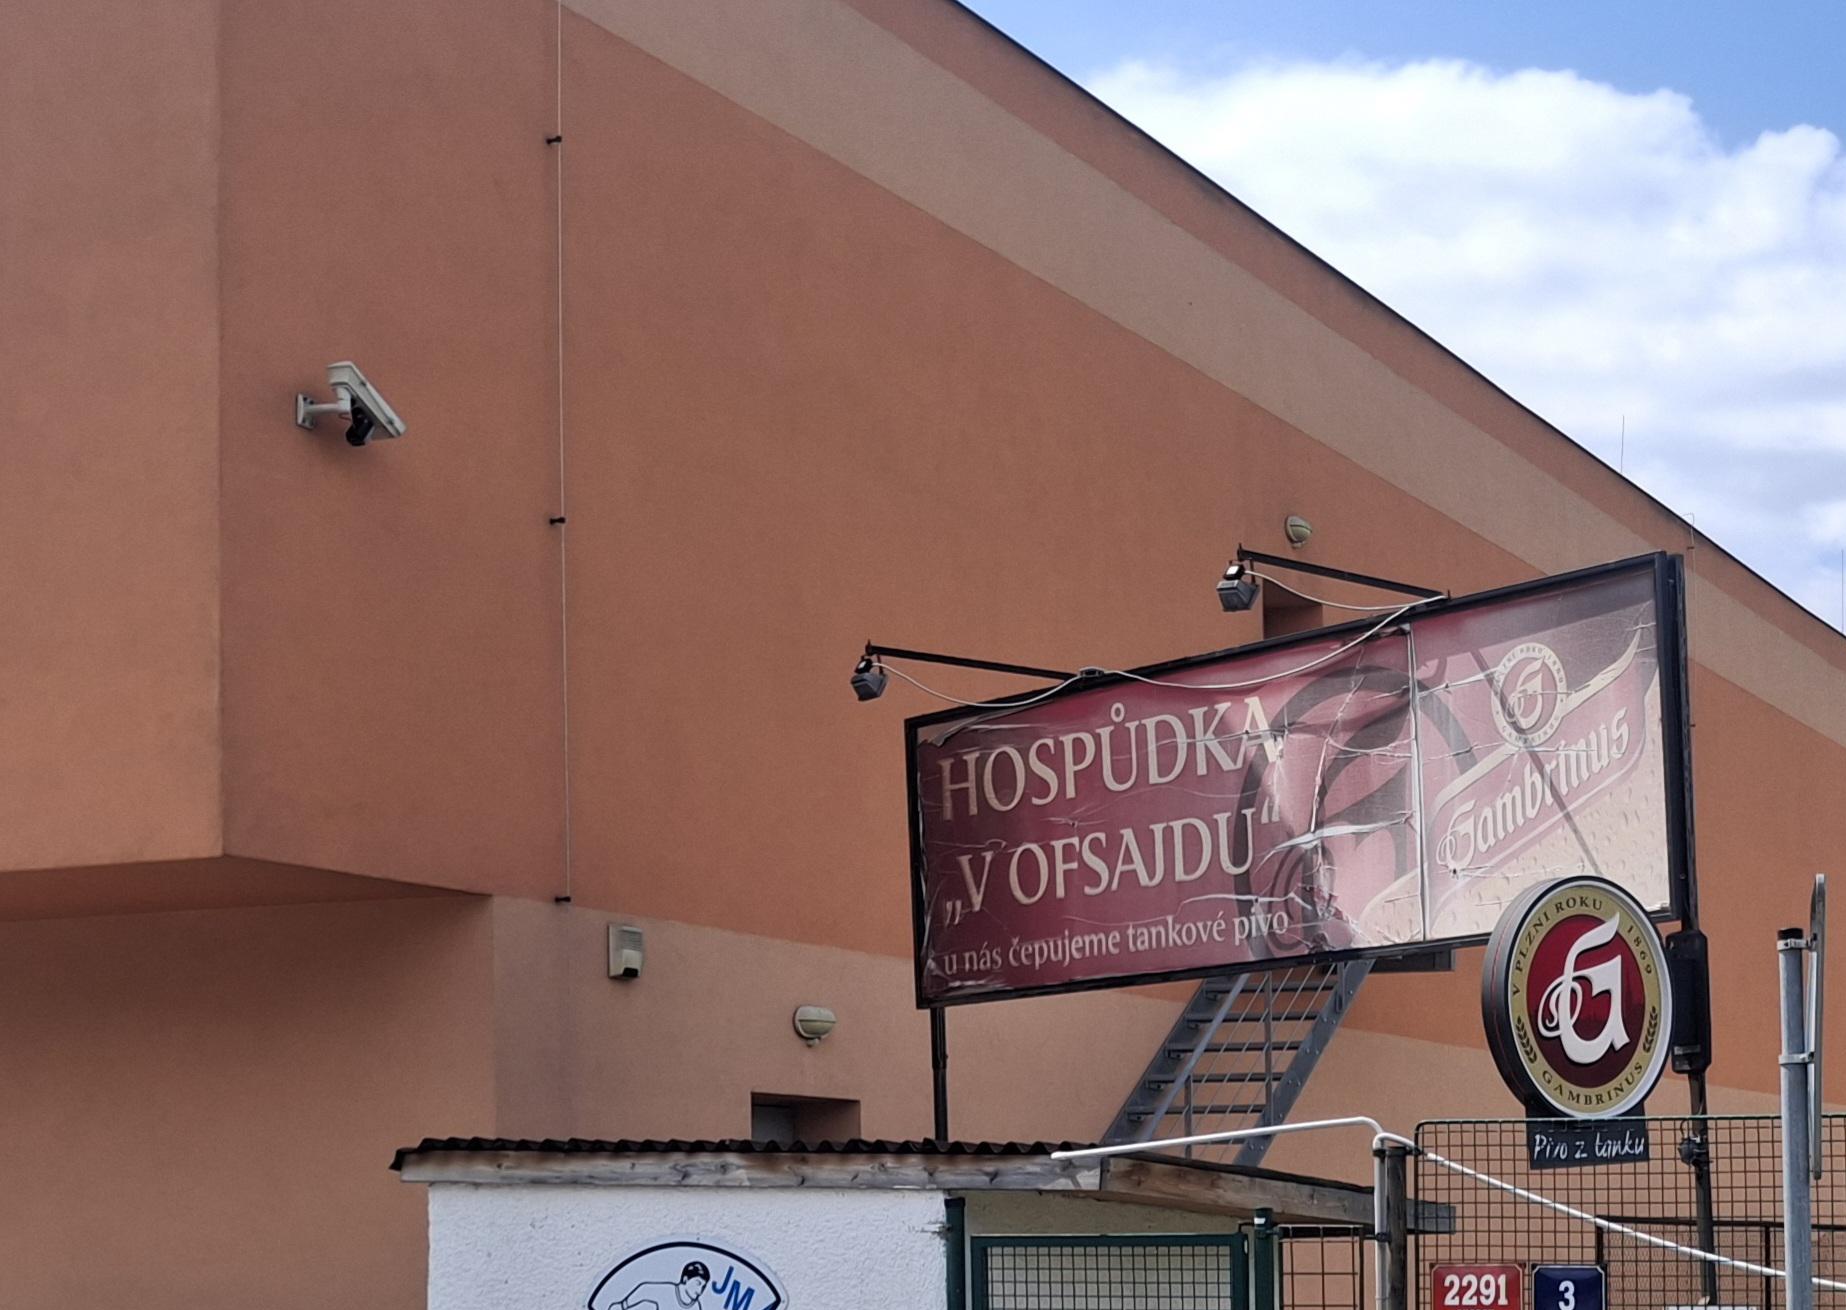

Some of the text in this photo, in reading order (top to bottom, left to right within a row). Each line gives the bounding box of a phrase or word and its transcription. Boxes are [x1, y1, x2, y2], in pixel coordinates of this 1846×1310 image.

[937, 696, 1283, 821] HOSPŮDKA
[1435, 706, 1630, 868] Gambrinus
[964, 942, 1002, 972] nás
[1008, 929, 1121, 969] čepujeme
[1126, 910, 1225, 953] tankové
[1232, 906, 1289, 946] pivo
[1514, 912, 1551, 973] PLZNI
[1555, 896, 1604, 914] ROKU
[1626, 924, 1653, 975] 1869
[1541, 1062, 1645, 1106] GAMBRINUS
[1574, 1141, 1588, 1159] z
[1594, 1129, 1645, 1159] tanku
[1443, 1273, 1509, 1306] 2291
